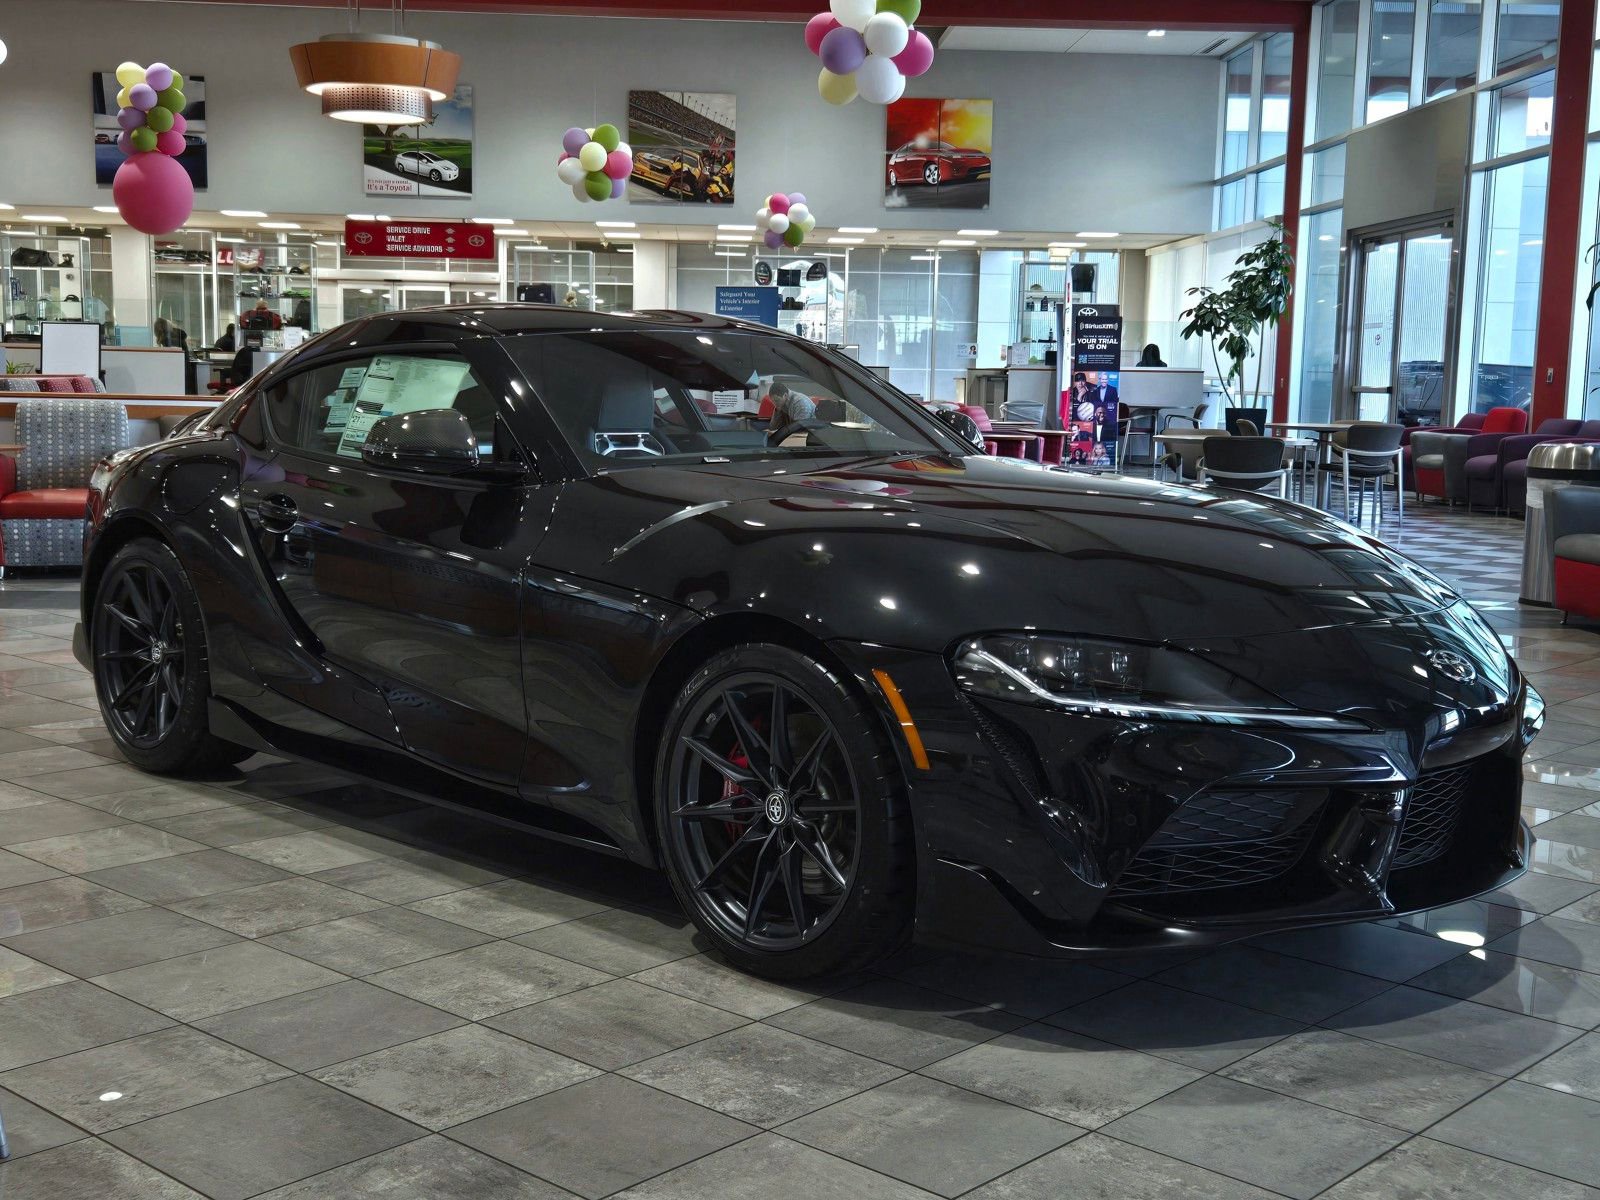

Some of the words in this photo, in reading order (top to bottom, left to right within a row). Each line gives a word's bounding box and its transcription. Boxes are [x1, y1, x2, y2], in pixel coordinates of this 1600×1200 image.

[412, 227, 431, 235] DRIVE
[386, 235, 405, 243] VALET
[386, 244, 412, 252] SERVICE
[412, 245, 442, 253] ADVISORS
